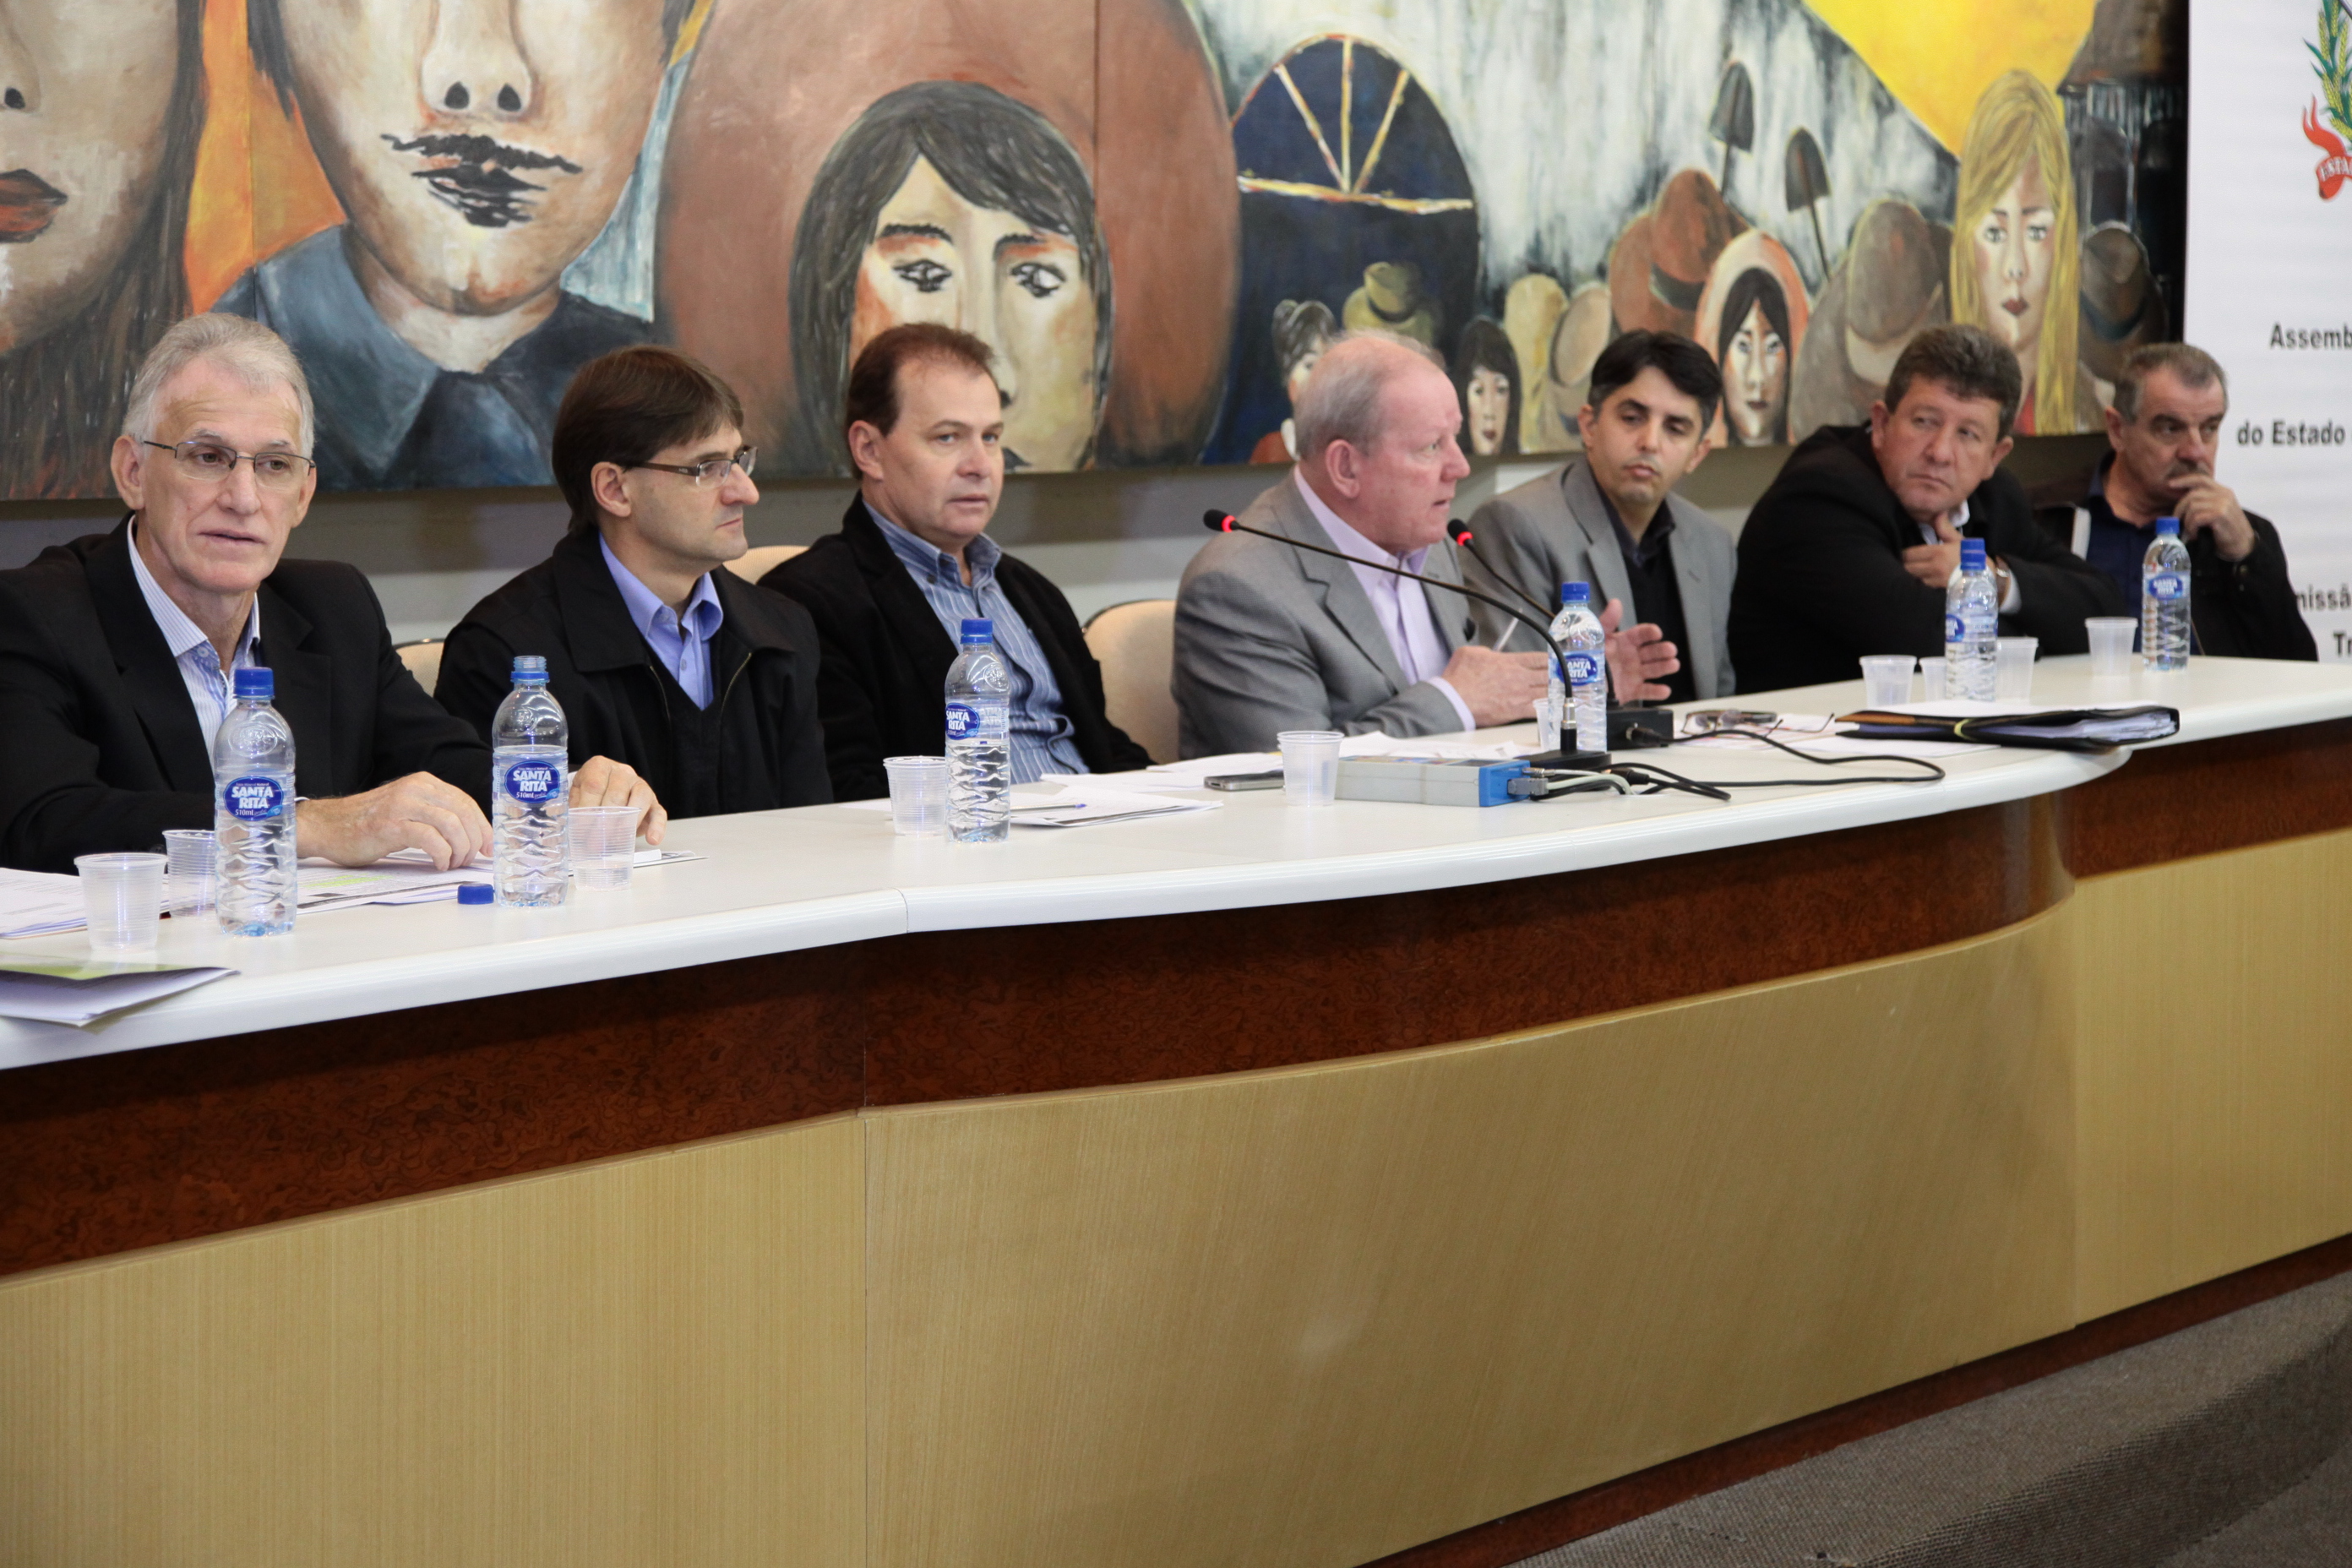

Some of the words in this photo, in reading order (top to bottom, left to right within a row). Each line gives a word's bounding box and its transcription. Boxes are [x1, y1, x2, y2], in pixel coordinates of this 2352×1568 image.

[2238, 420, 2263, 445] do
[2273, 420, 2345, 445] Estado
[1567, 661, 1591, 670] ANTA
[948, 720, 966, 731] RITA
[513, 770, 552, 781] SANTA
[520, 781, 547, 792] RITA
[231, 787, 274, 798] SANTA
[238, 798, 269, 808] RITA
